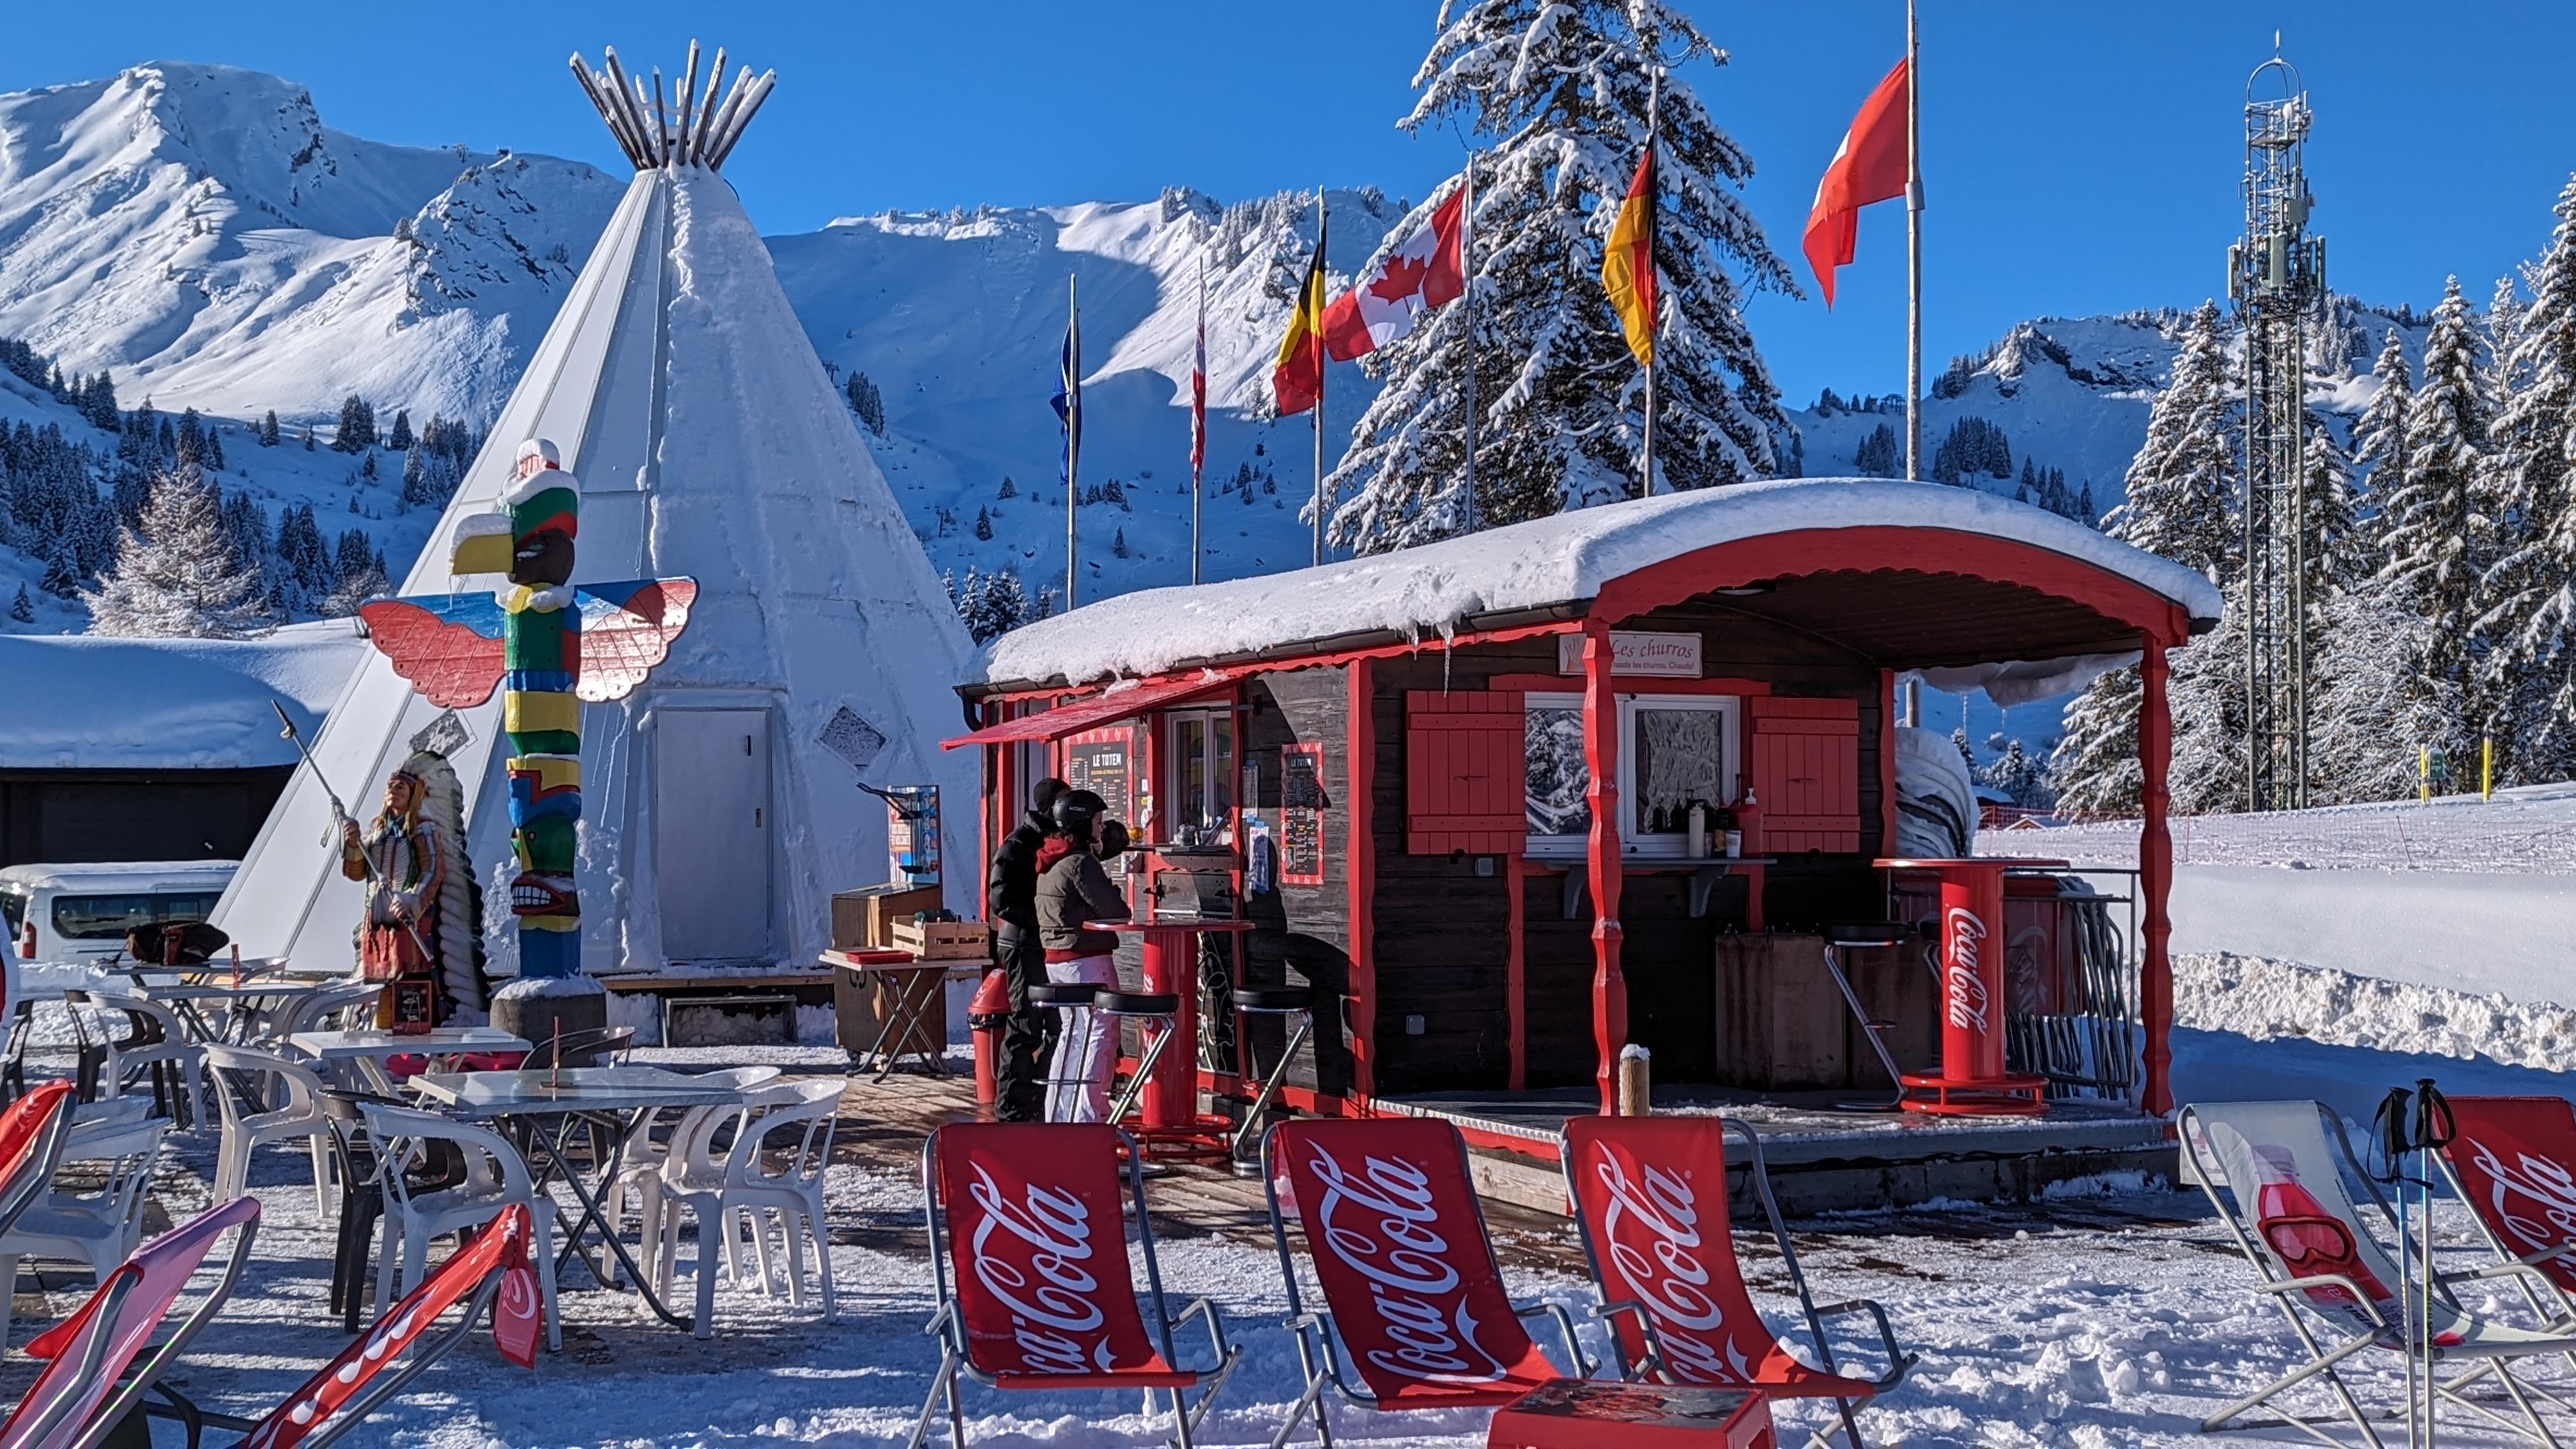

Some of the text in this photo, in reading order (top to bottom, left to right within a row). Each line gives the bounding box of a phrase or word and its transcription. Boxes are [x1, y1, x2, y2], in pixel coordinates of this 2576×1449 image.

[1612, 639, 1693, 658] Les churros
[1092, 753, 1122, 767] LE TOTEM
